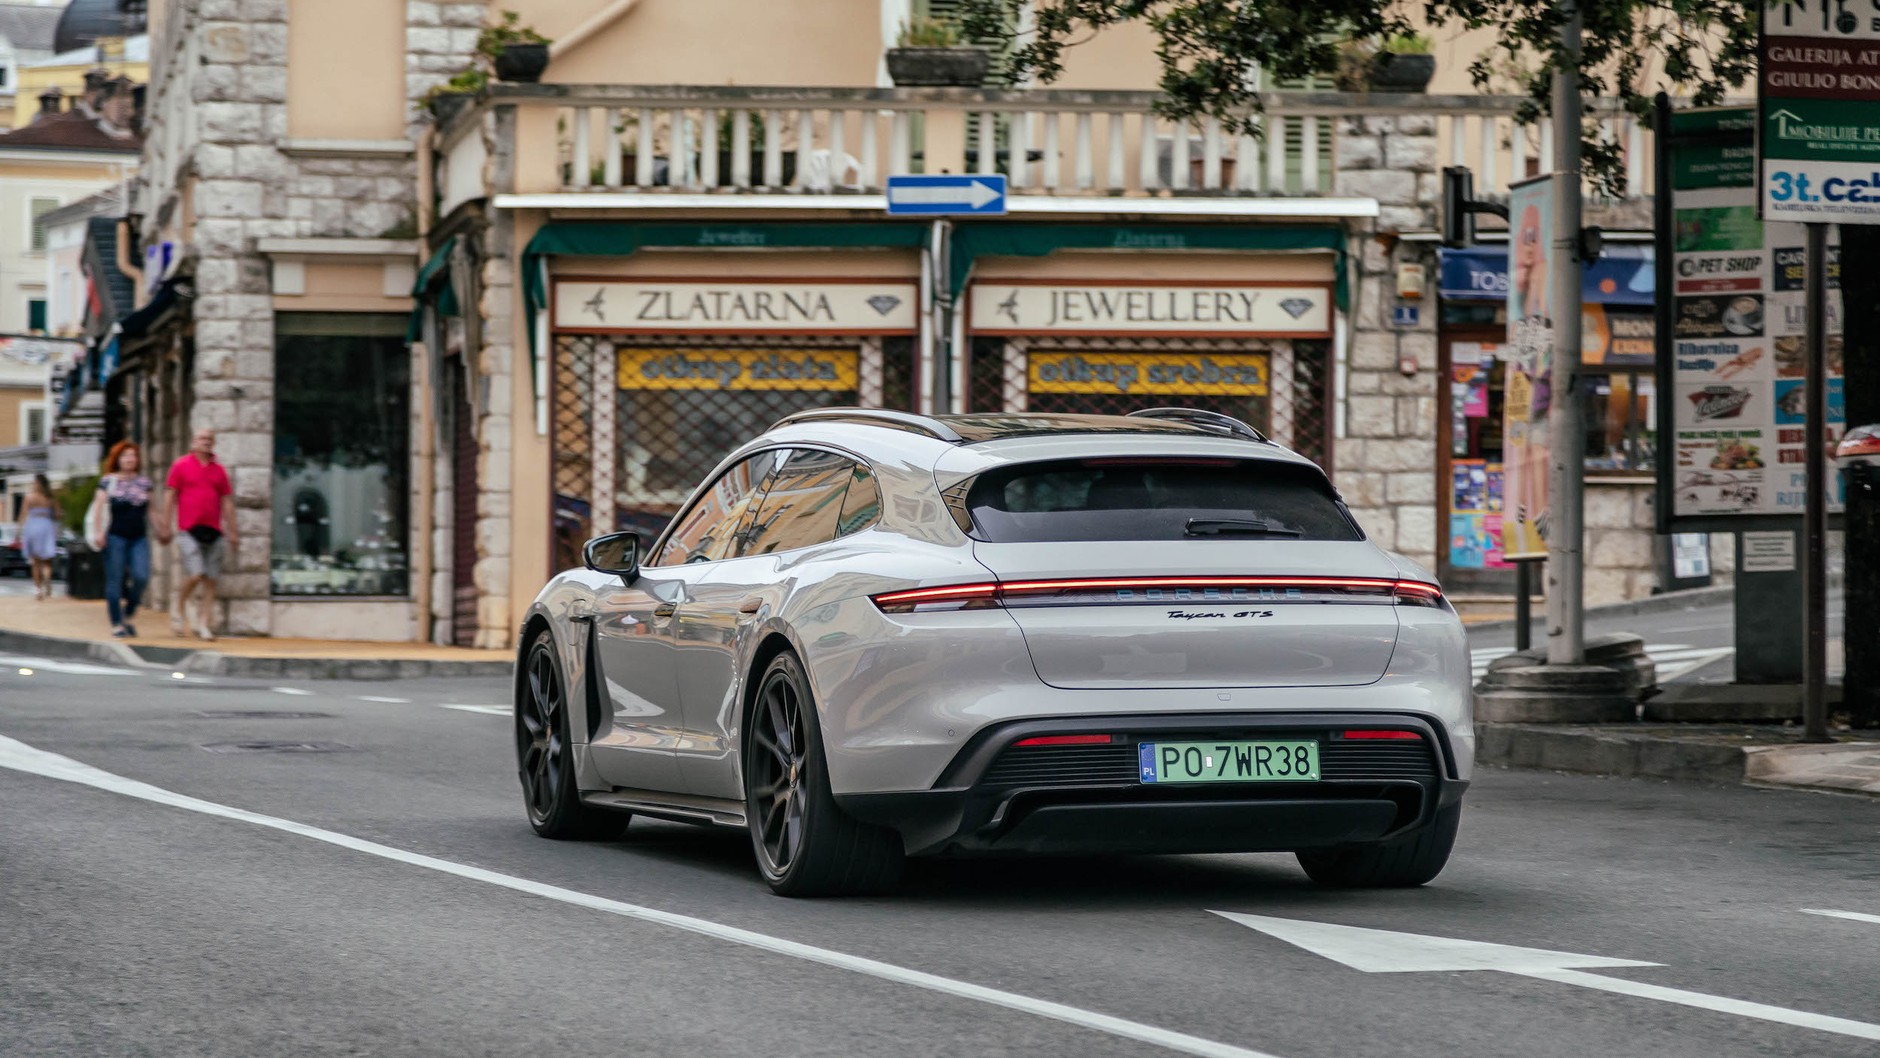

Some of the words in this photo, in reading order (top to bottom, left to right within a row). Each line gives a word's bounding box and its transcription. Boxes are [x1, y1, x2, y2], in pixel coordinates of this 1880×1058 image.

[1768, 46, 1853, 67] GALERIJA
[1768, 71, 1837, 89] GIULIO
[1699, 257, 1723, 273] PET
[1725, 256, 1762, 272] SHOP
[637, 291, 836, 321] ZLATARNA
[1047, 291, 1261, 326] JEWELLERY
[640, 354, 742, 386] otkup
[750, 355, 839, 381] zlata
[1038, 357, 1139, 391] otkup
[1147, 359, 1260, 384] srebra
[1115, 588, 1304, 600] PORSCHE
[1167, 610, 1226, 621] Taycan
[1232, 610, 1274, 618] GTS
[1143, 767, 1155, 776] PL
[1161, 746, 1204, 778] PO
[1215, 745, 1311, 777] 7WR38
